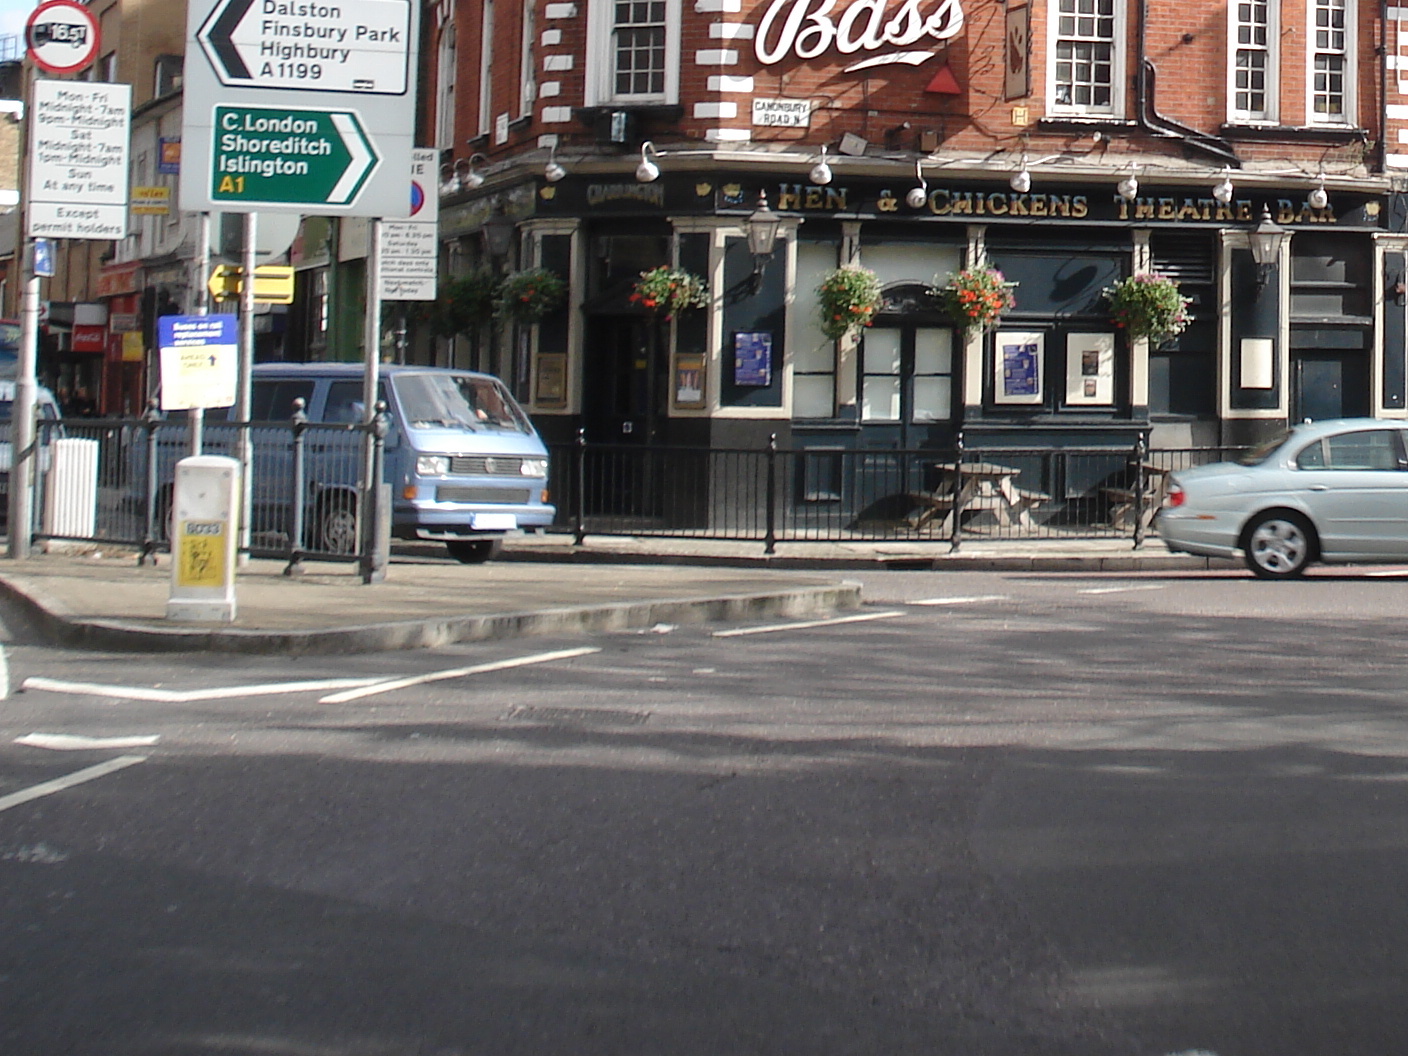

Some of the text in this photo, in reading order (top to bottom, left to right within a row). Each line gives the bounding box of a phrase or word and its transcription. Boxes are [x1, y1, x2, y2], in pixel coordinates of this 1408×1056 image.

[263, 0, 341, 19] Dalston
[262, 20, 400, 43] Finsbury Park
[261, 41, 350, 63] Highbury
[764, 114, 790, 125] ROAD
[70, 129, 92, 140] Sat
[221, 133, 332, 156] Shoreditch
[68, 168, 92, 179] Sun
[219, 154, 309, 178] Islington
[43, 180, 114, 193] At any time
[218, 175, 245, 193] A1
[778, 183, 848, 210] HEN
[877, 189, 899, 212] &
[928, 189, 1088, 218] CHICKENS
[1113, 194, 1253, 220] THEATRE
[56, 207, 99, 219] Except
[32, 223, 121, 235] permit holders
